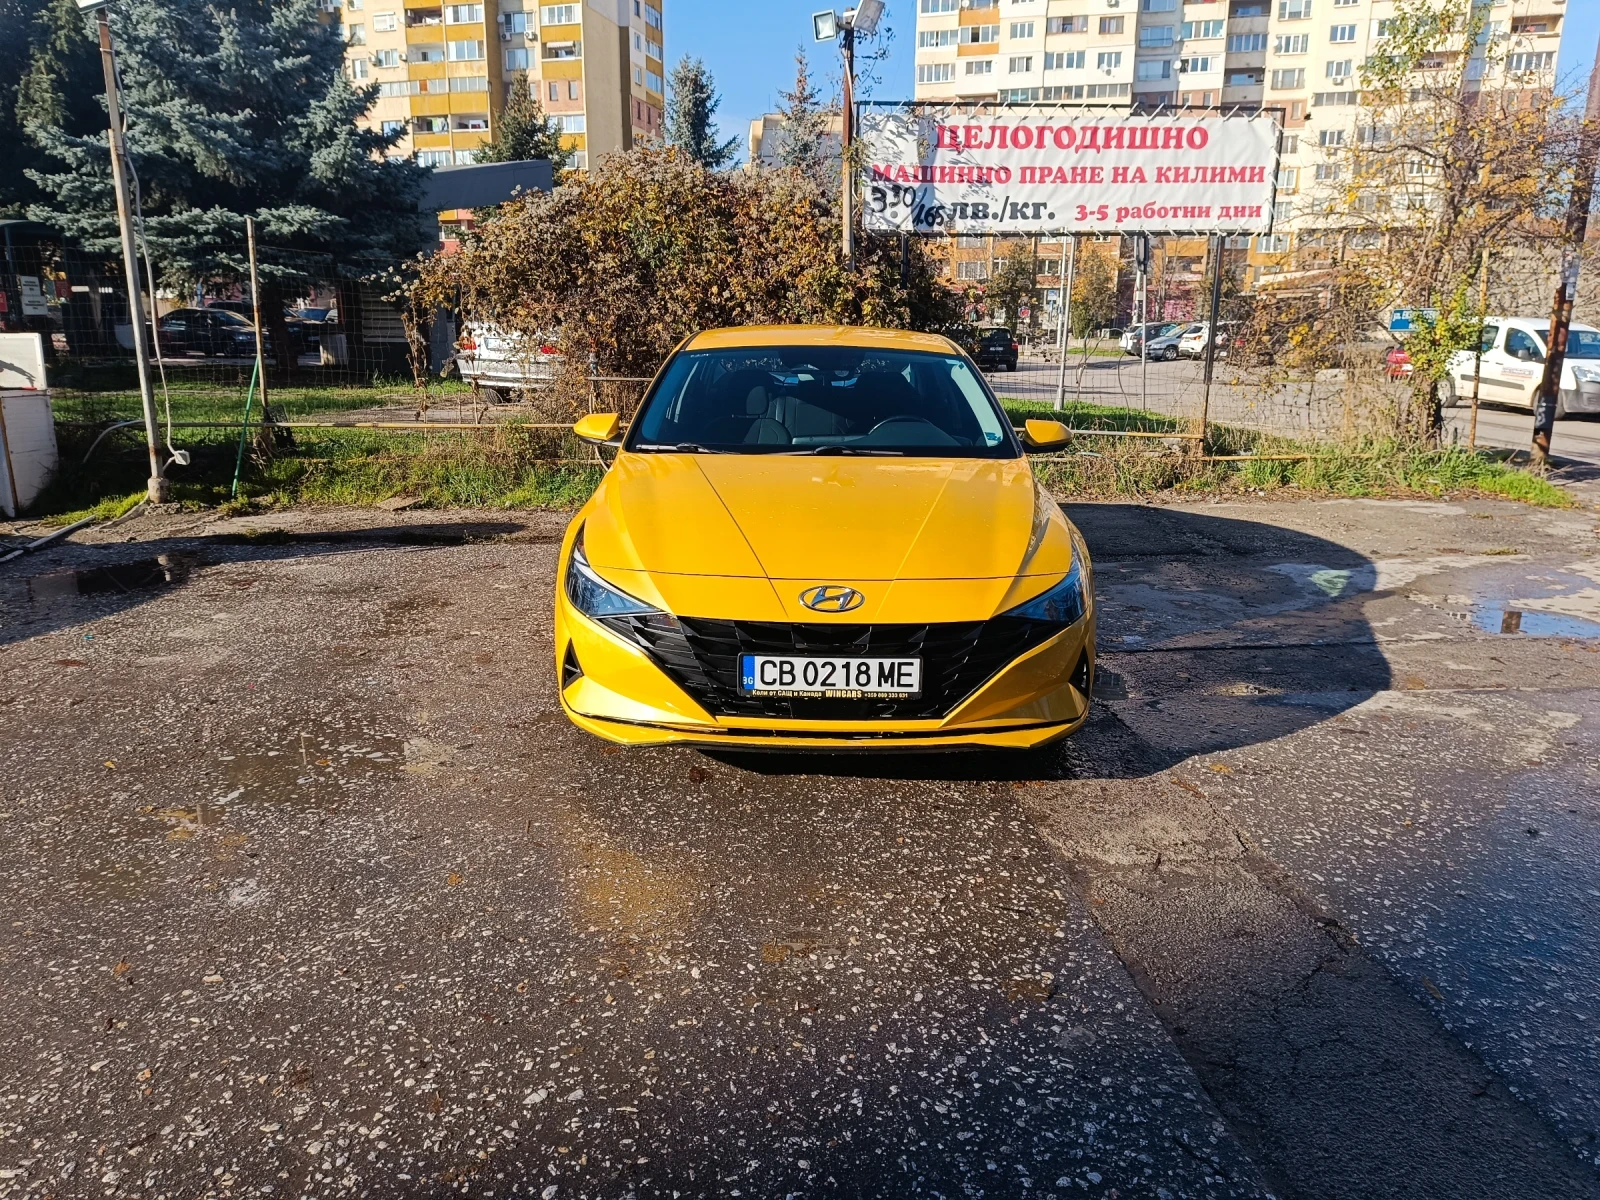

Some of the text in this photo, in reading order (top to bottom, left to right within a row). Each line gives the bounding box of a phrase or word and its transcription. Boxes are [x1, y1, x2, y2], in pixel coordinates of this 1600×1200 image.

[937, 125, 1209, 154] ЦЕЛОГОДИШНО
[871, 164, 1266, 184] МАШИННО ПРАНЕ НА КИЛИМИ
[1075, 201, 1262, 222] 3-5 работни дни
[760, 660, 914, 688] CB 0218 ME
